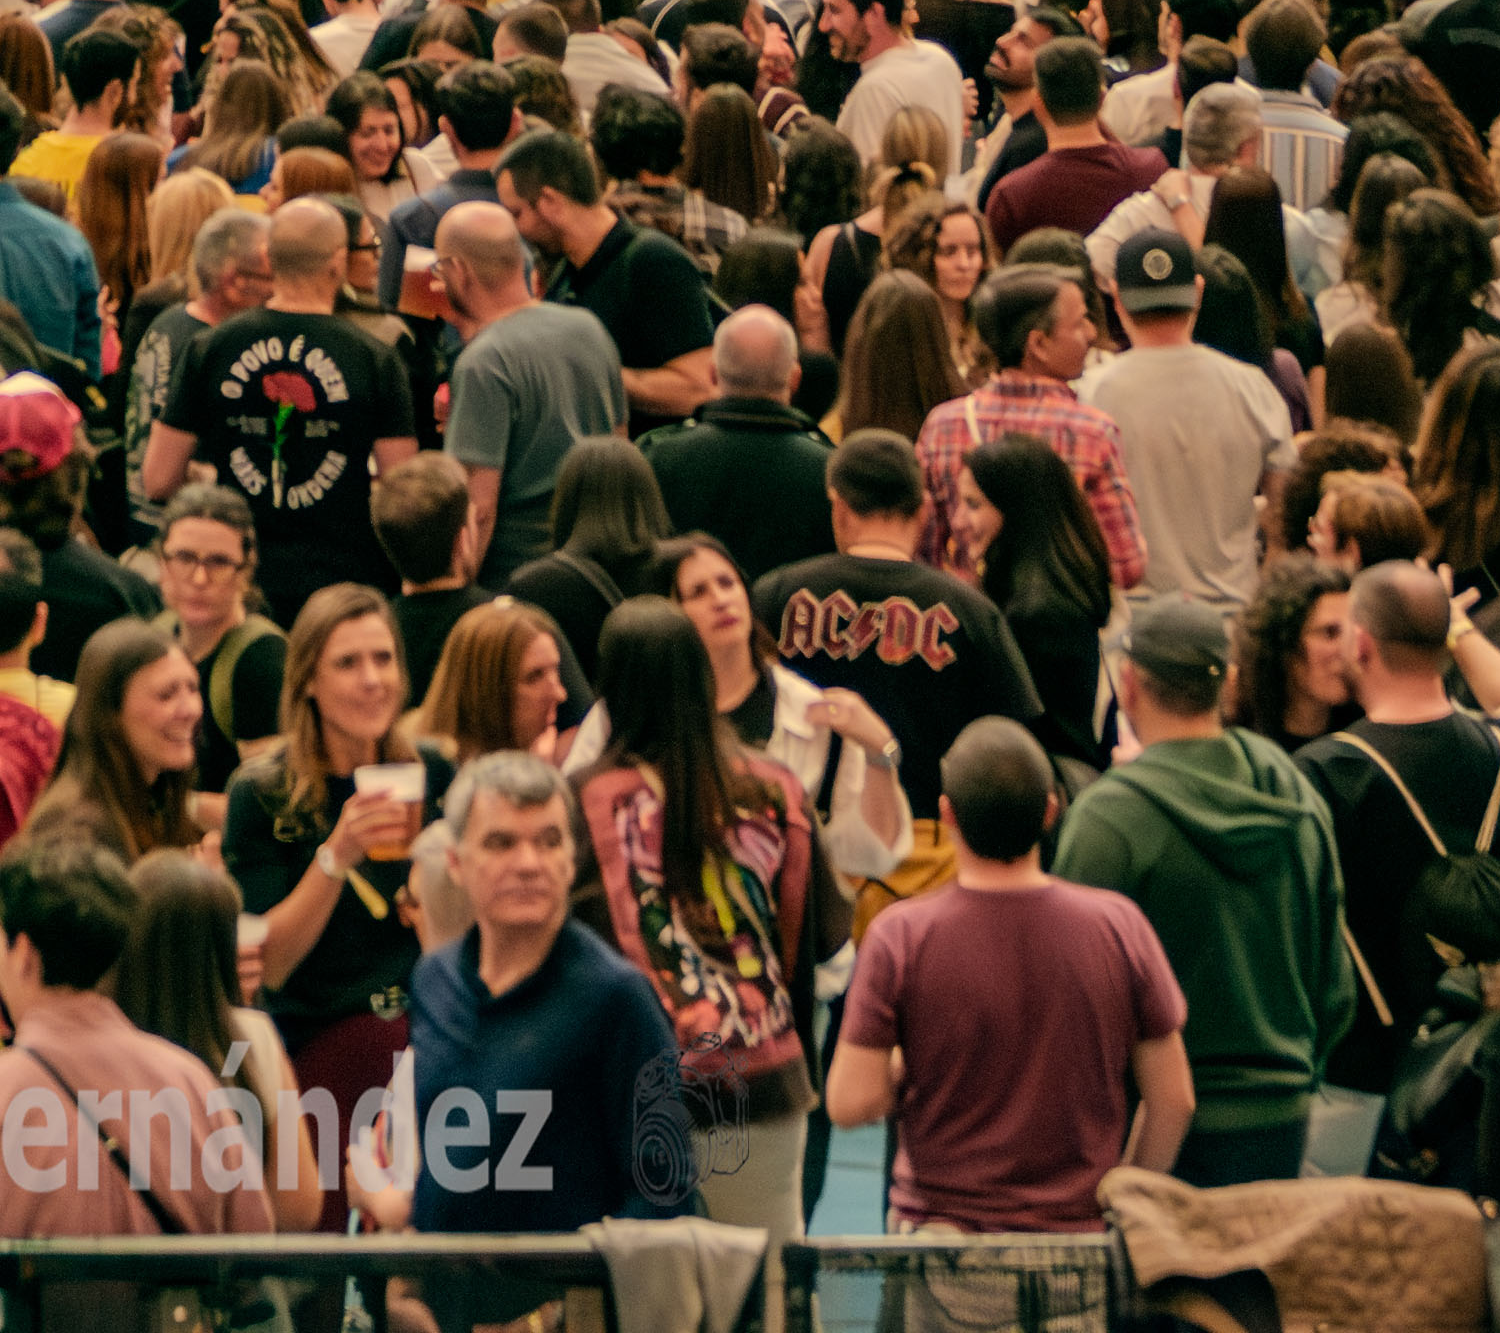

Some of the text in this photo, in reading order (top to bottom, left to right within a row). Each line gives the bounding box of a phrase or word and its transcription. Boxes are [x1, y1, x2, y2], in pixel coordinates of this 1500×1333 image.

[229, 336, 284, 383] POVO
[304, 347, 350, 404] QUEM
[220, 379, 244, 399] O
